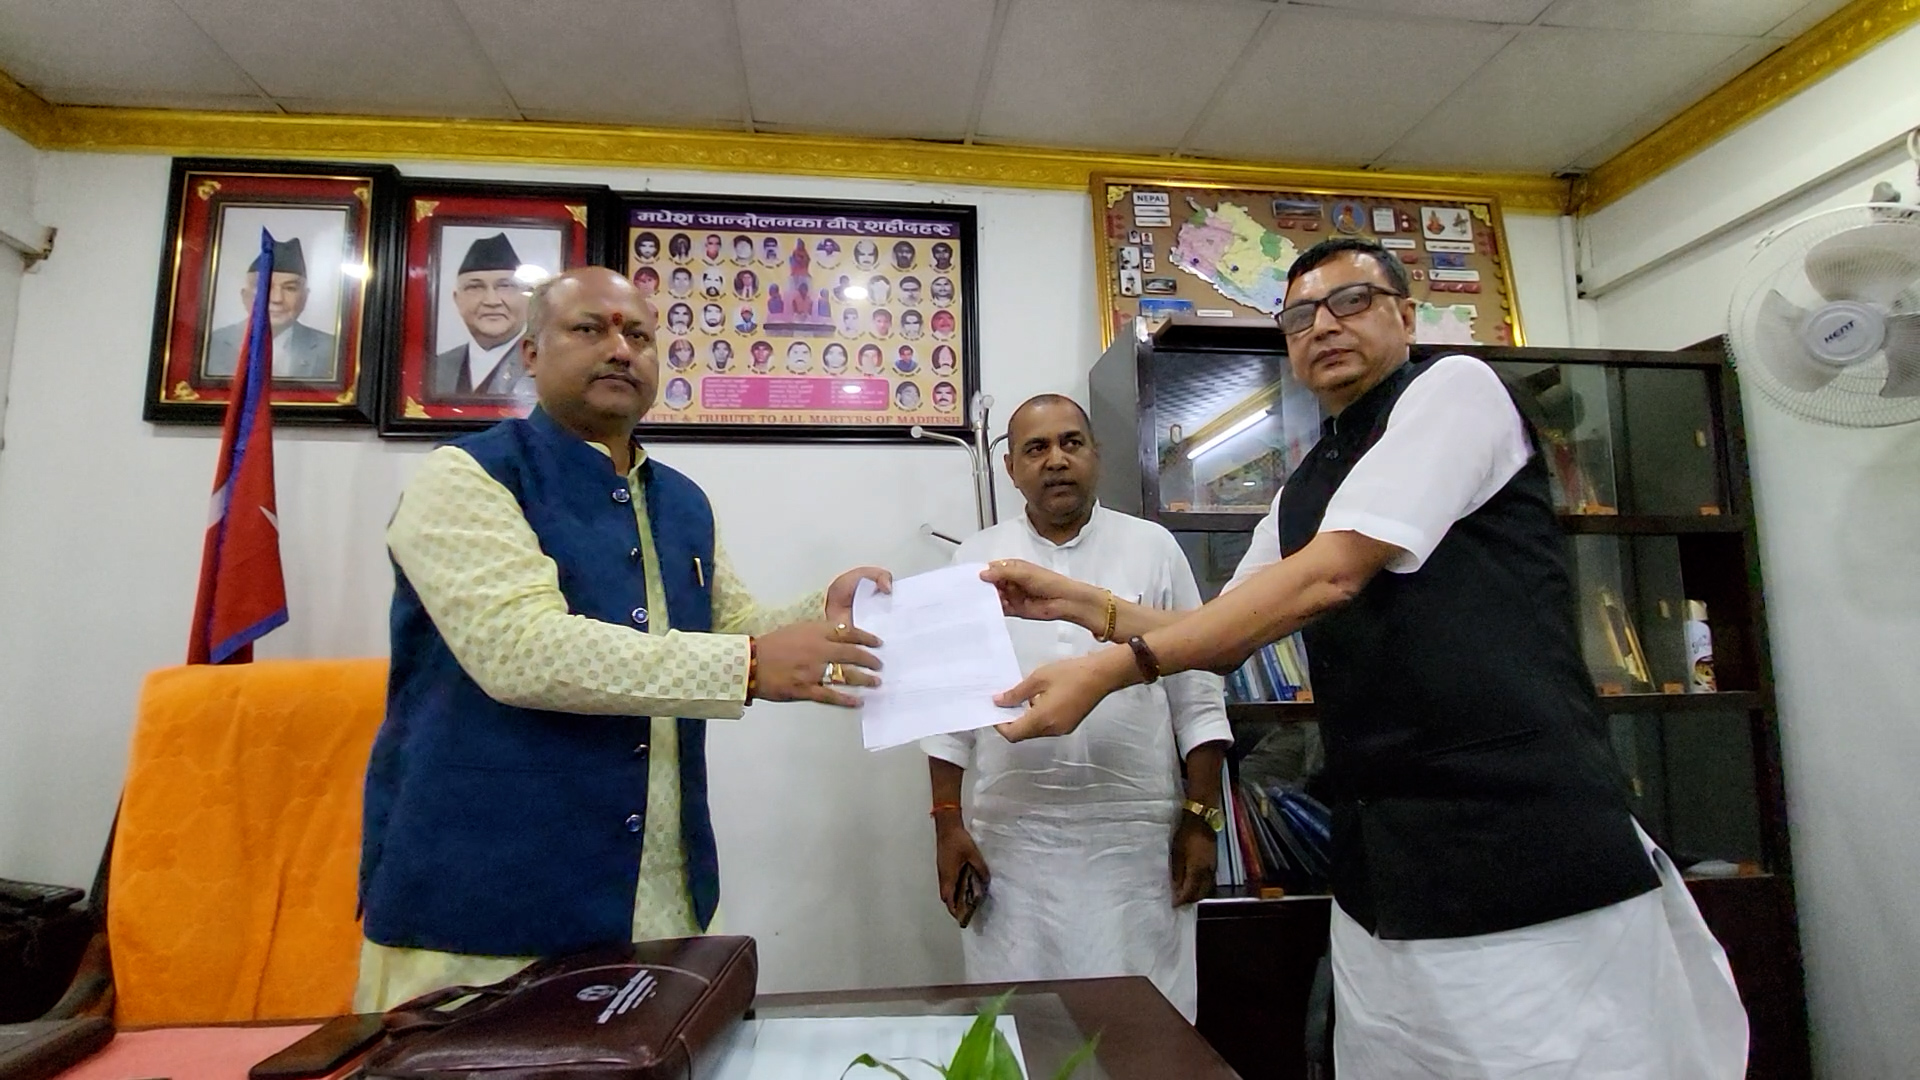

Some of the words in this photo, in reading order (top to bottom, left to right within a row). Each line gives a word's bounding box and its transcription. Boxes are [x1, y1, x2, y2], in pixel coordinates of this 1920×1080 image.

[1136, 195, 1166, 203] NEPAL
[637, 209, 695, 226] मधेश
[698, 213, 821, 228] आन्दोलनका
[826, 217, 865, 233] वीर
[697, 413, 755, 423] TRIBUTE
[759, 414, 777, 423] TO
[781, 415, 805, 424] ALL
[809, 415, 873, 424] MARTYRS
[876, 415, 894, 424] OF
[897, 416, 961, 425] MADHESH
